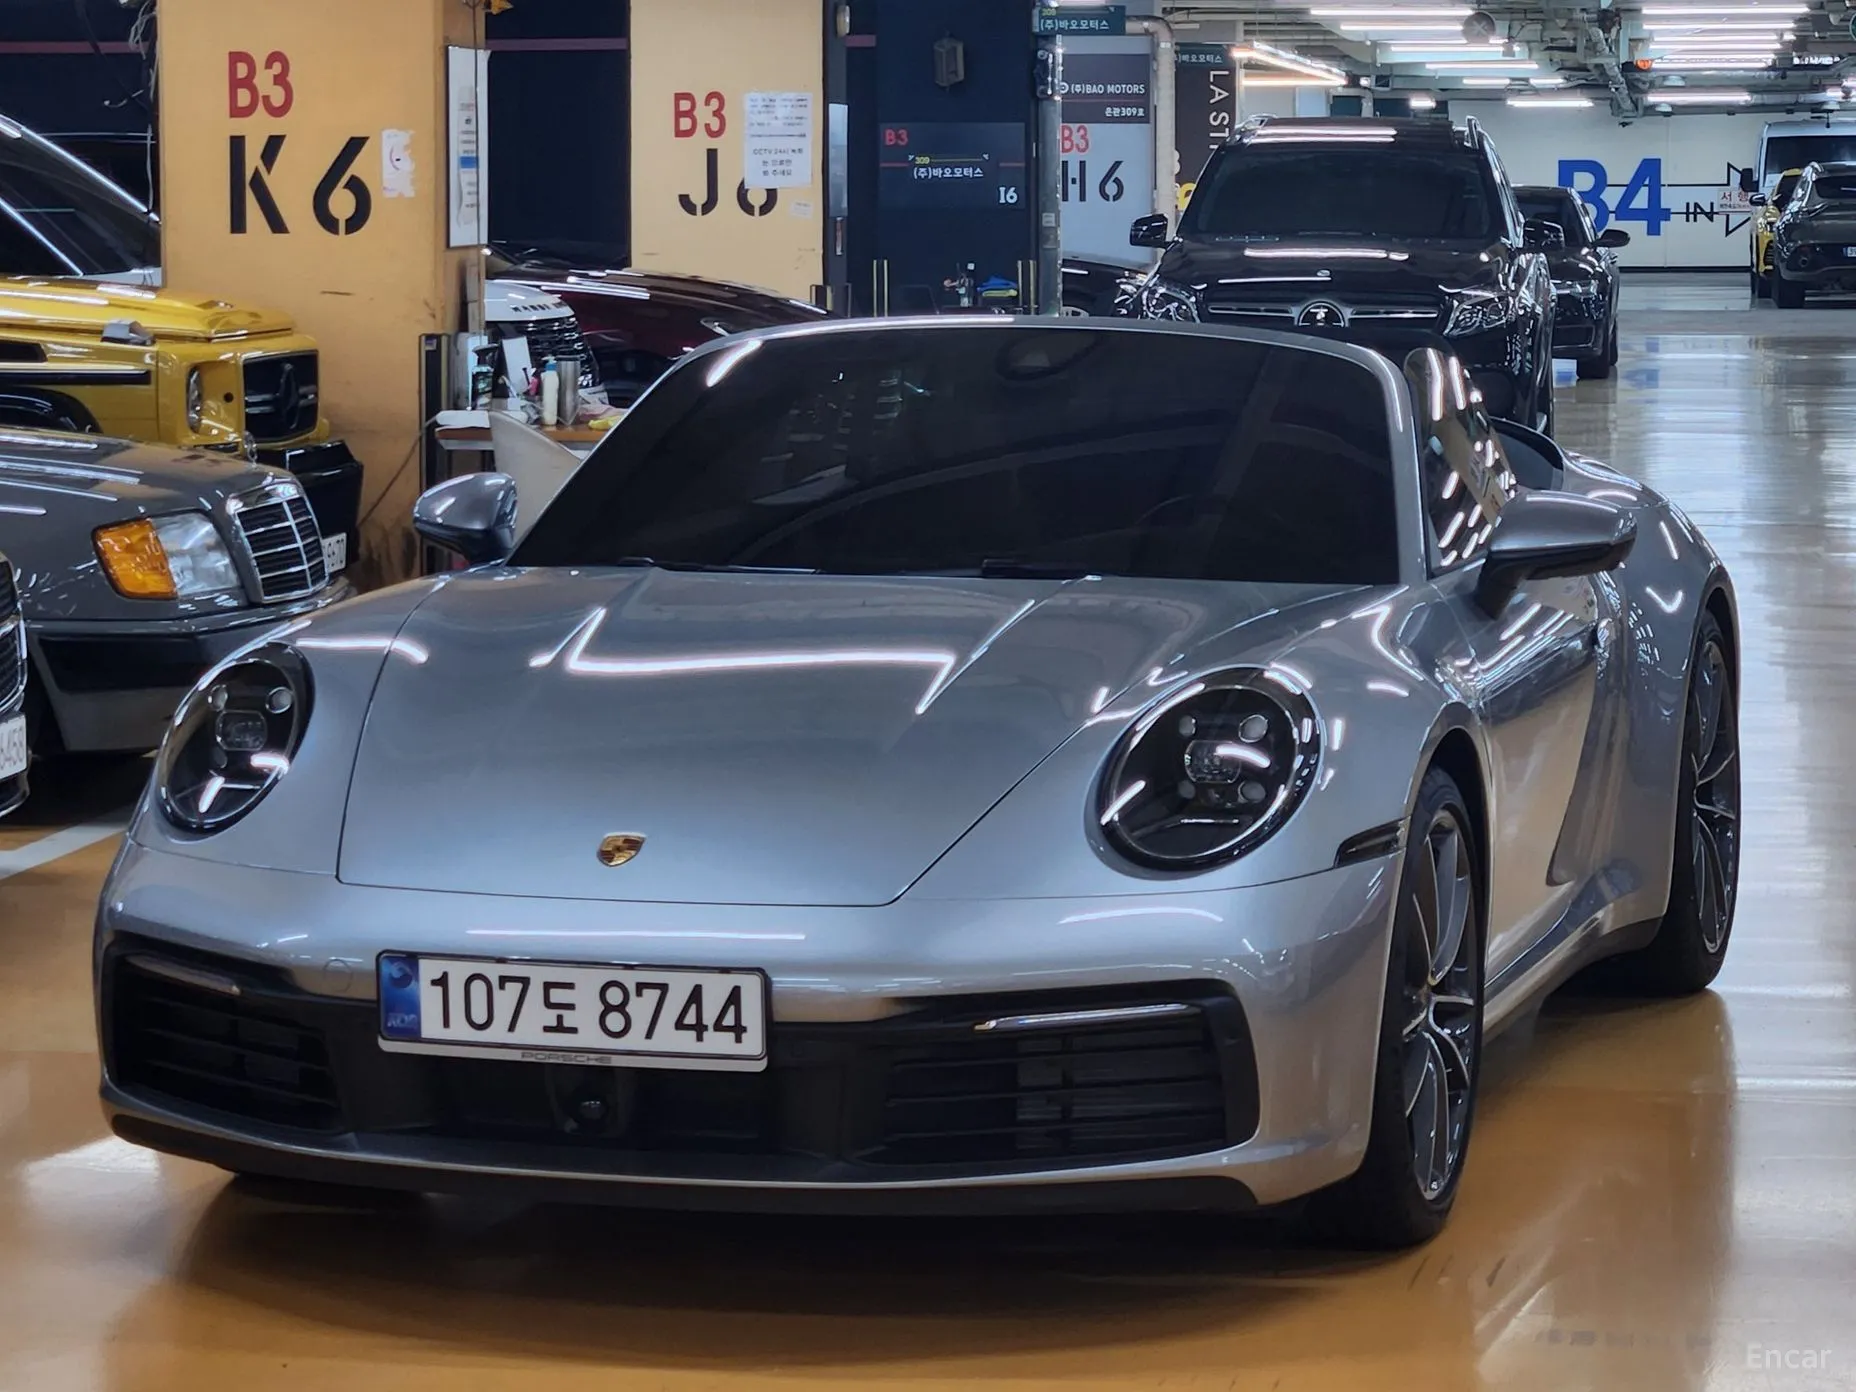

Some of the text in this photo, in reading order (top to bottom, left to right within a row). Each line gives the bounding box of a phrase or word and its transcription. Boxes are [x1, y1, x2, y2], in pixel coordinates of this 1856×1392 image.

[1040, 19, 1110, 31] (주)바오모터스
[1174, 54, 1223, 63] )바오모터스
[228, 51, 293, 118] B3
[1107, 83, 1146, 94] MOTORS
[674, 92, 727, 138] B3
[884, 129, 908, 146] B3
[1061, 124, 1089, 154] B3
[913, 167, 984, 179] (주)바오모터스
[1558, 158, 1671, 236] B4
[1685, 201, 1714, 223] IN
[430, 971, 748, 1044] 107도 8744
[521, 1051, 612, 1065] PORSCHE
